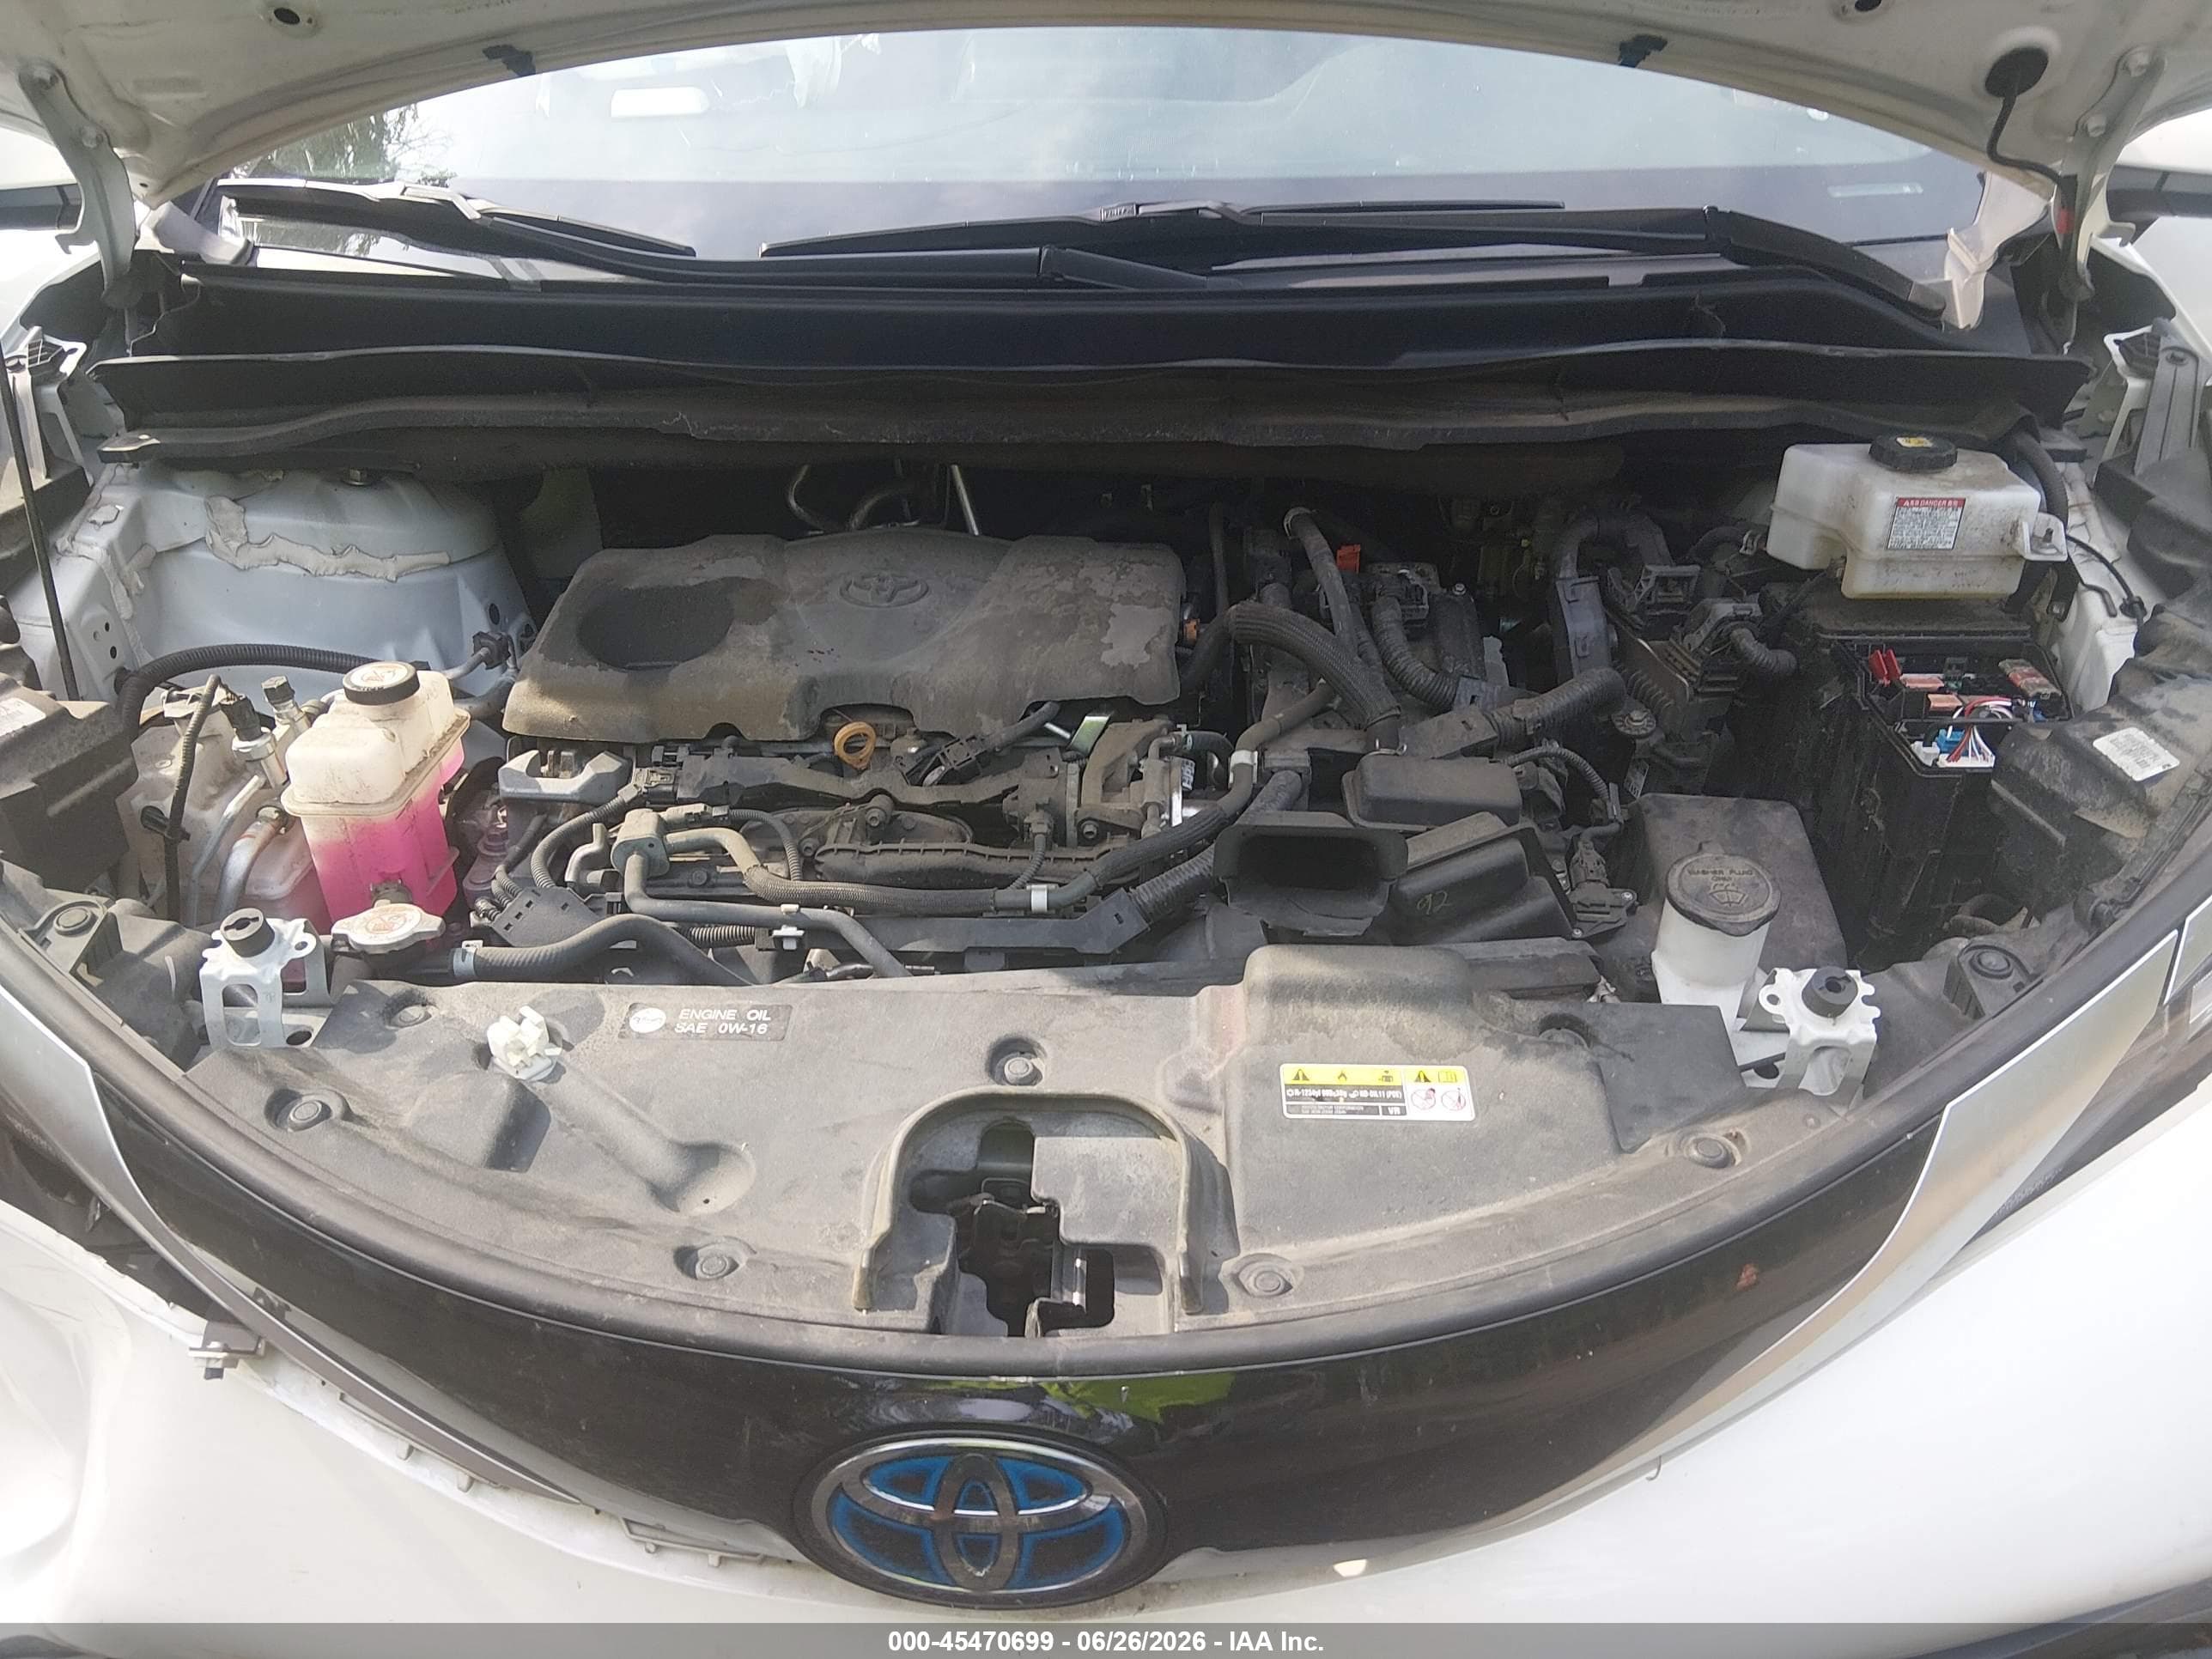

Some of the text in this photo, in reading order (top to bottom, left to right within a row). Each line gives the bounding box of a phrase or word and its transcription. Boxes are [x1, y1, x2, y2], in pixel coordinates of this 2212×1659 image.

[679, 1009, 772, 1021] ENGINE OIL
[675, 1023, 768, 1034] SAE 0W-16
